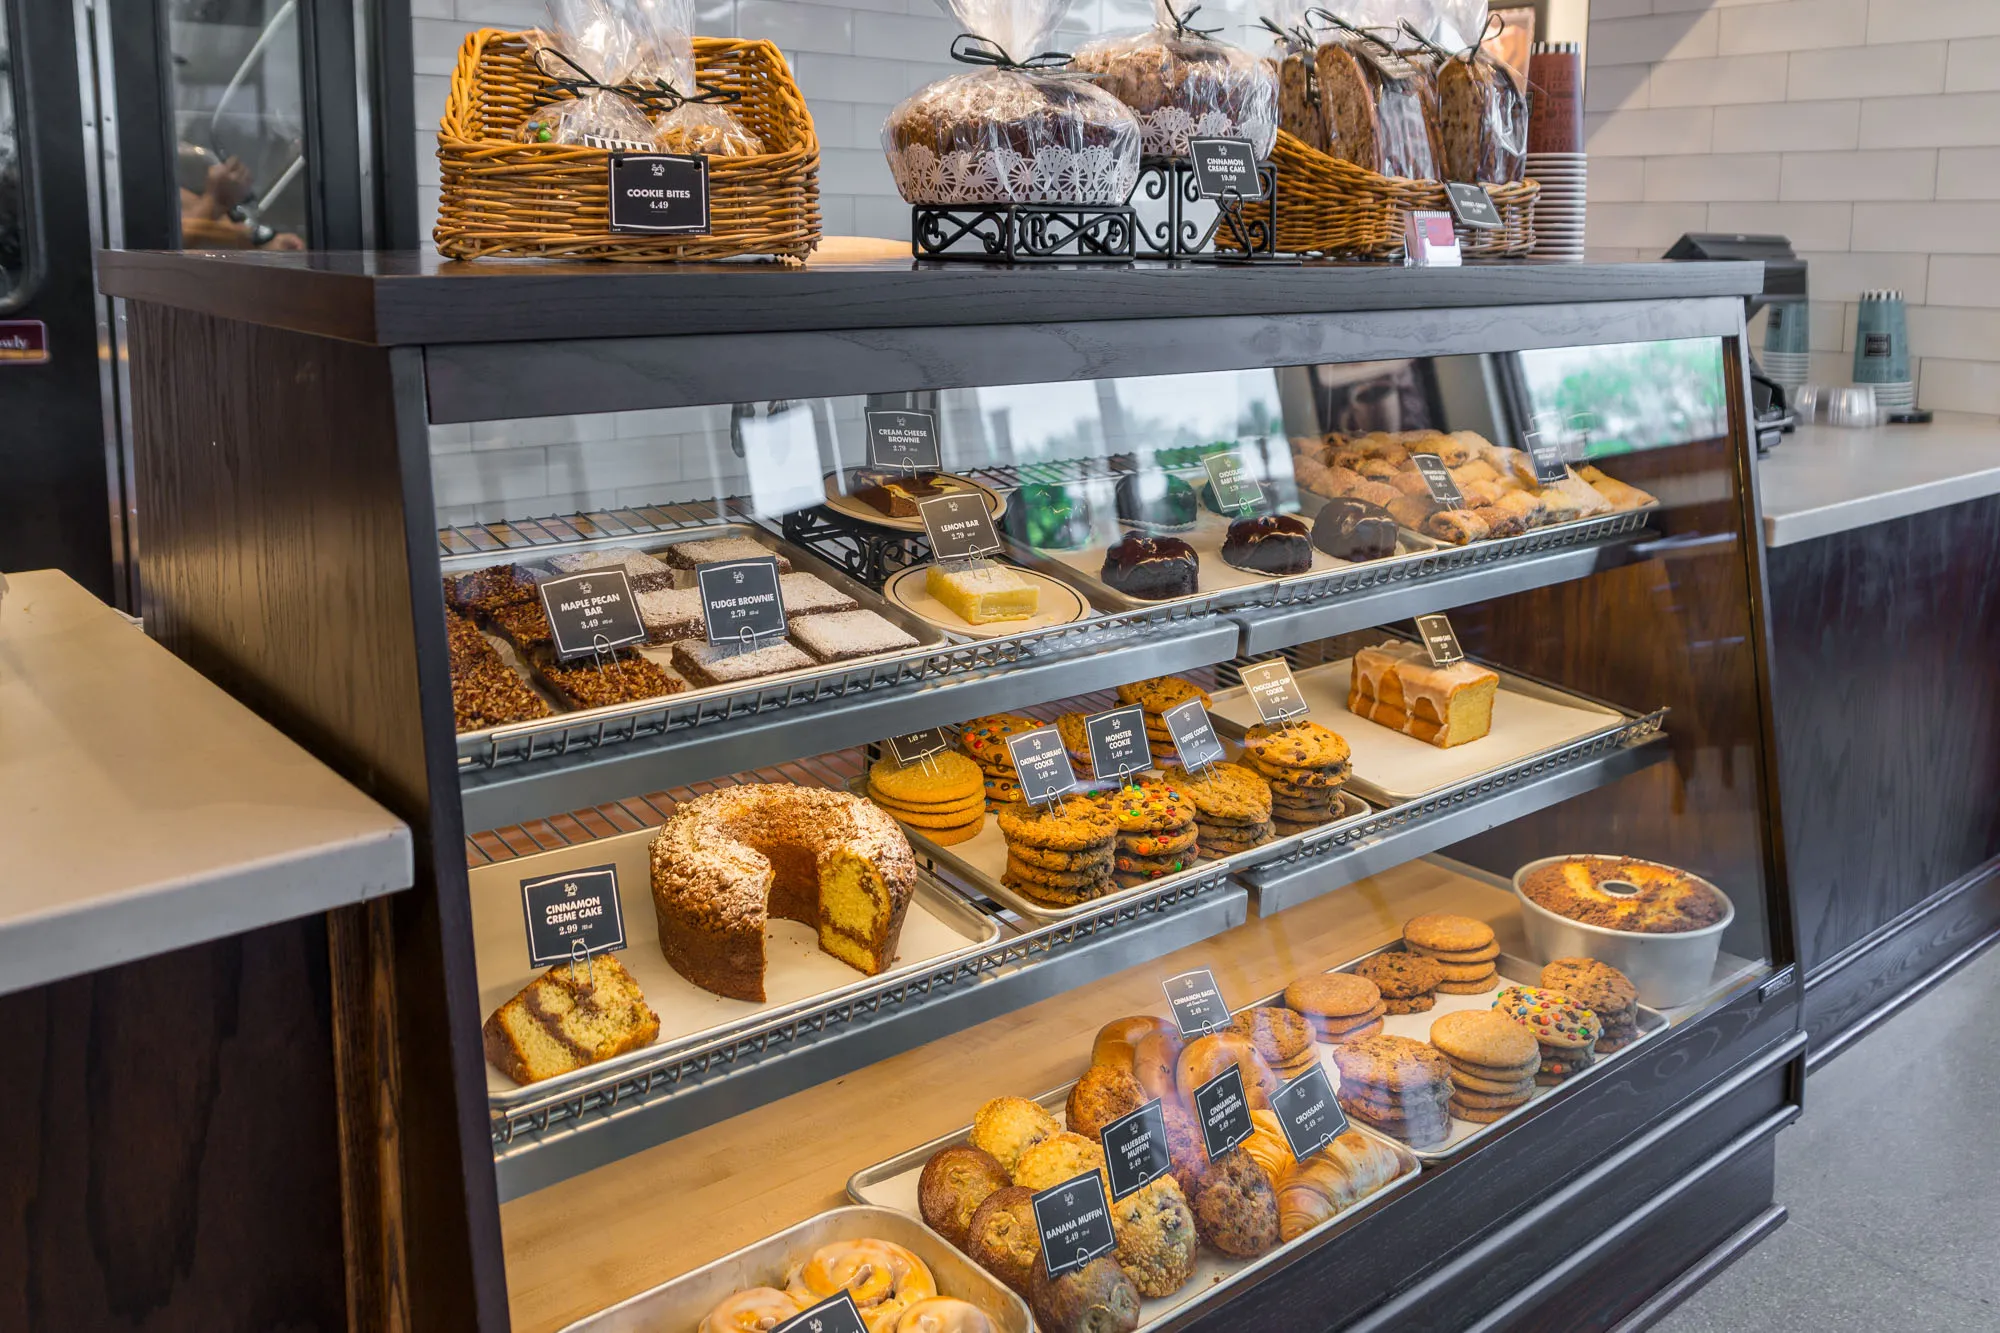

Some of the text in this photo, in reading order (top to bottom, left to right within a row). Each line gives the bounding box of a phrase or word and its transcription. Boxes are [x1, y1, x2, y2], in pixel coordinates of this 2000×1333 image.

[1206, 158, 1244, 166] CINNAMON
[627, 189, 690, 198] COOKIE BITES
[650, 201, 668, 209] 4.49
[941, 520, 979, 532] LEMON BAR
[951, 532, 964, 540] 2.79
[561, 593, 620, 612] MAPLE PECAN
[711, 594, 774, 610] FUDGE BROWNIE
[584, 607, 603, 617] BAR
[731, 609, 746, 618] 2.79
[581, 619, 598, 629] 3.49
[1253, 680, 1280, 693] CHOCOLATE
[1266, 686, 1284, 696] COOKIE
[1105, 730, 1132, 743] MONSTER
[1180, 732, 1194, 743] TOFFEE
[1194, 725, 1208, 737] COOKIE
[1109, 738, 1131, 750] COOKIE
[1020, 748, 1062, 766] OATMEAL CURRANT
[1112, 750, 1122, 759] 1.49
[1034, 759, 1054, 770] COOKIE
[546, 896, 600, 914] CINNAMON
[546, 906, 602, 925] CREME CAKE
[559, 924, 578, 935] 2.99
[1174, 989, 1216, 1005] CINNAMON BAGEL
[1210, 1093, 1237, 1116] CINNAMON
[1208, 1112, 1225, 1127] CRUMB
[1224, 1099, 1242, 1116] MUFFIN
[1295, 1100, 1325, 1124] CROISSANT
[1304, 1119, 1316, 1132] 2.49
[1121, 1130, 1152, 1154] BLUEBERRY
[1127, 1141, 1150, 1160] MUFFIN
[1129, 1157, 1142, 1170] 2.49
[1046, 1220, 1077, 1240] BANANA
[1078, 1208, 1103, 1226] MUFFIN
[1065, 1231, 1079, 1244] 2.49
